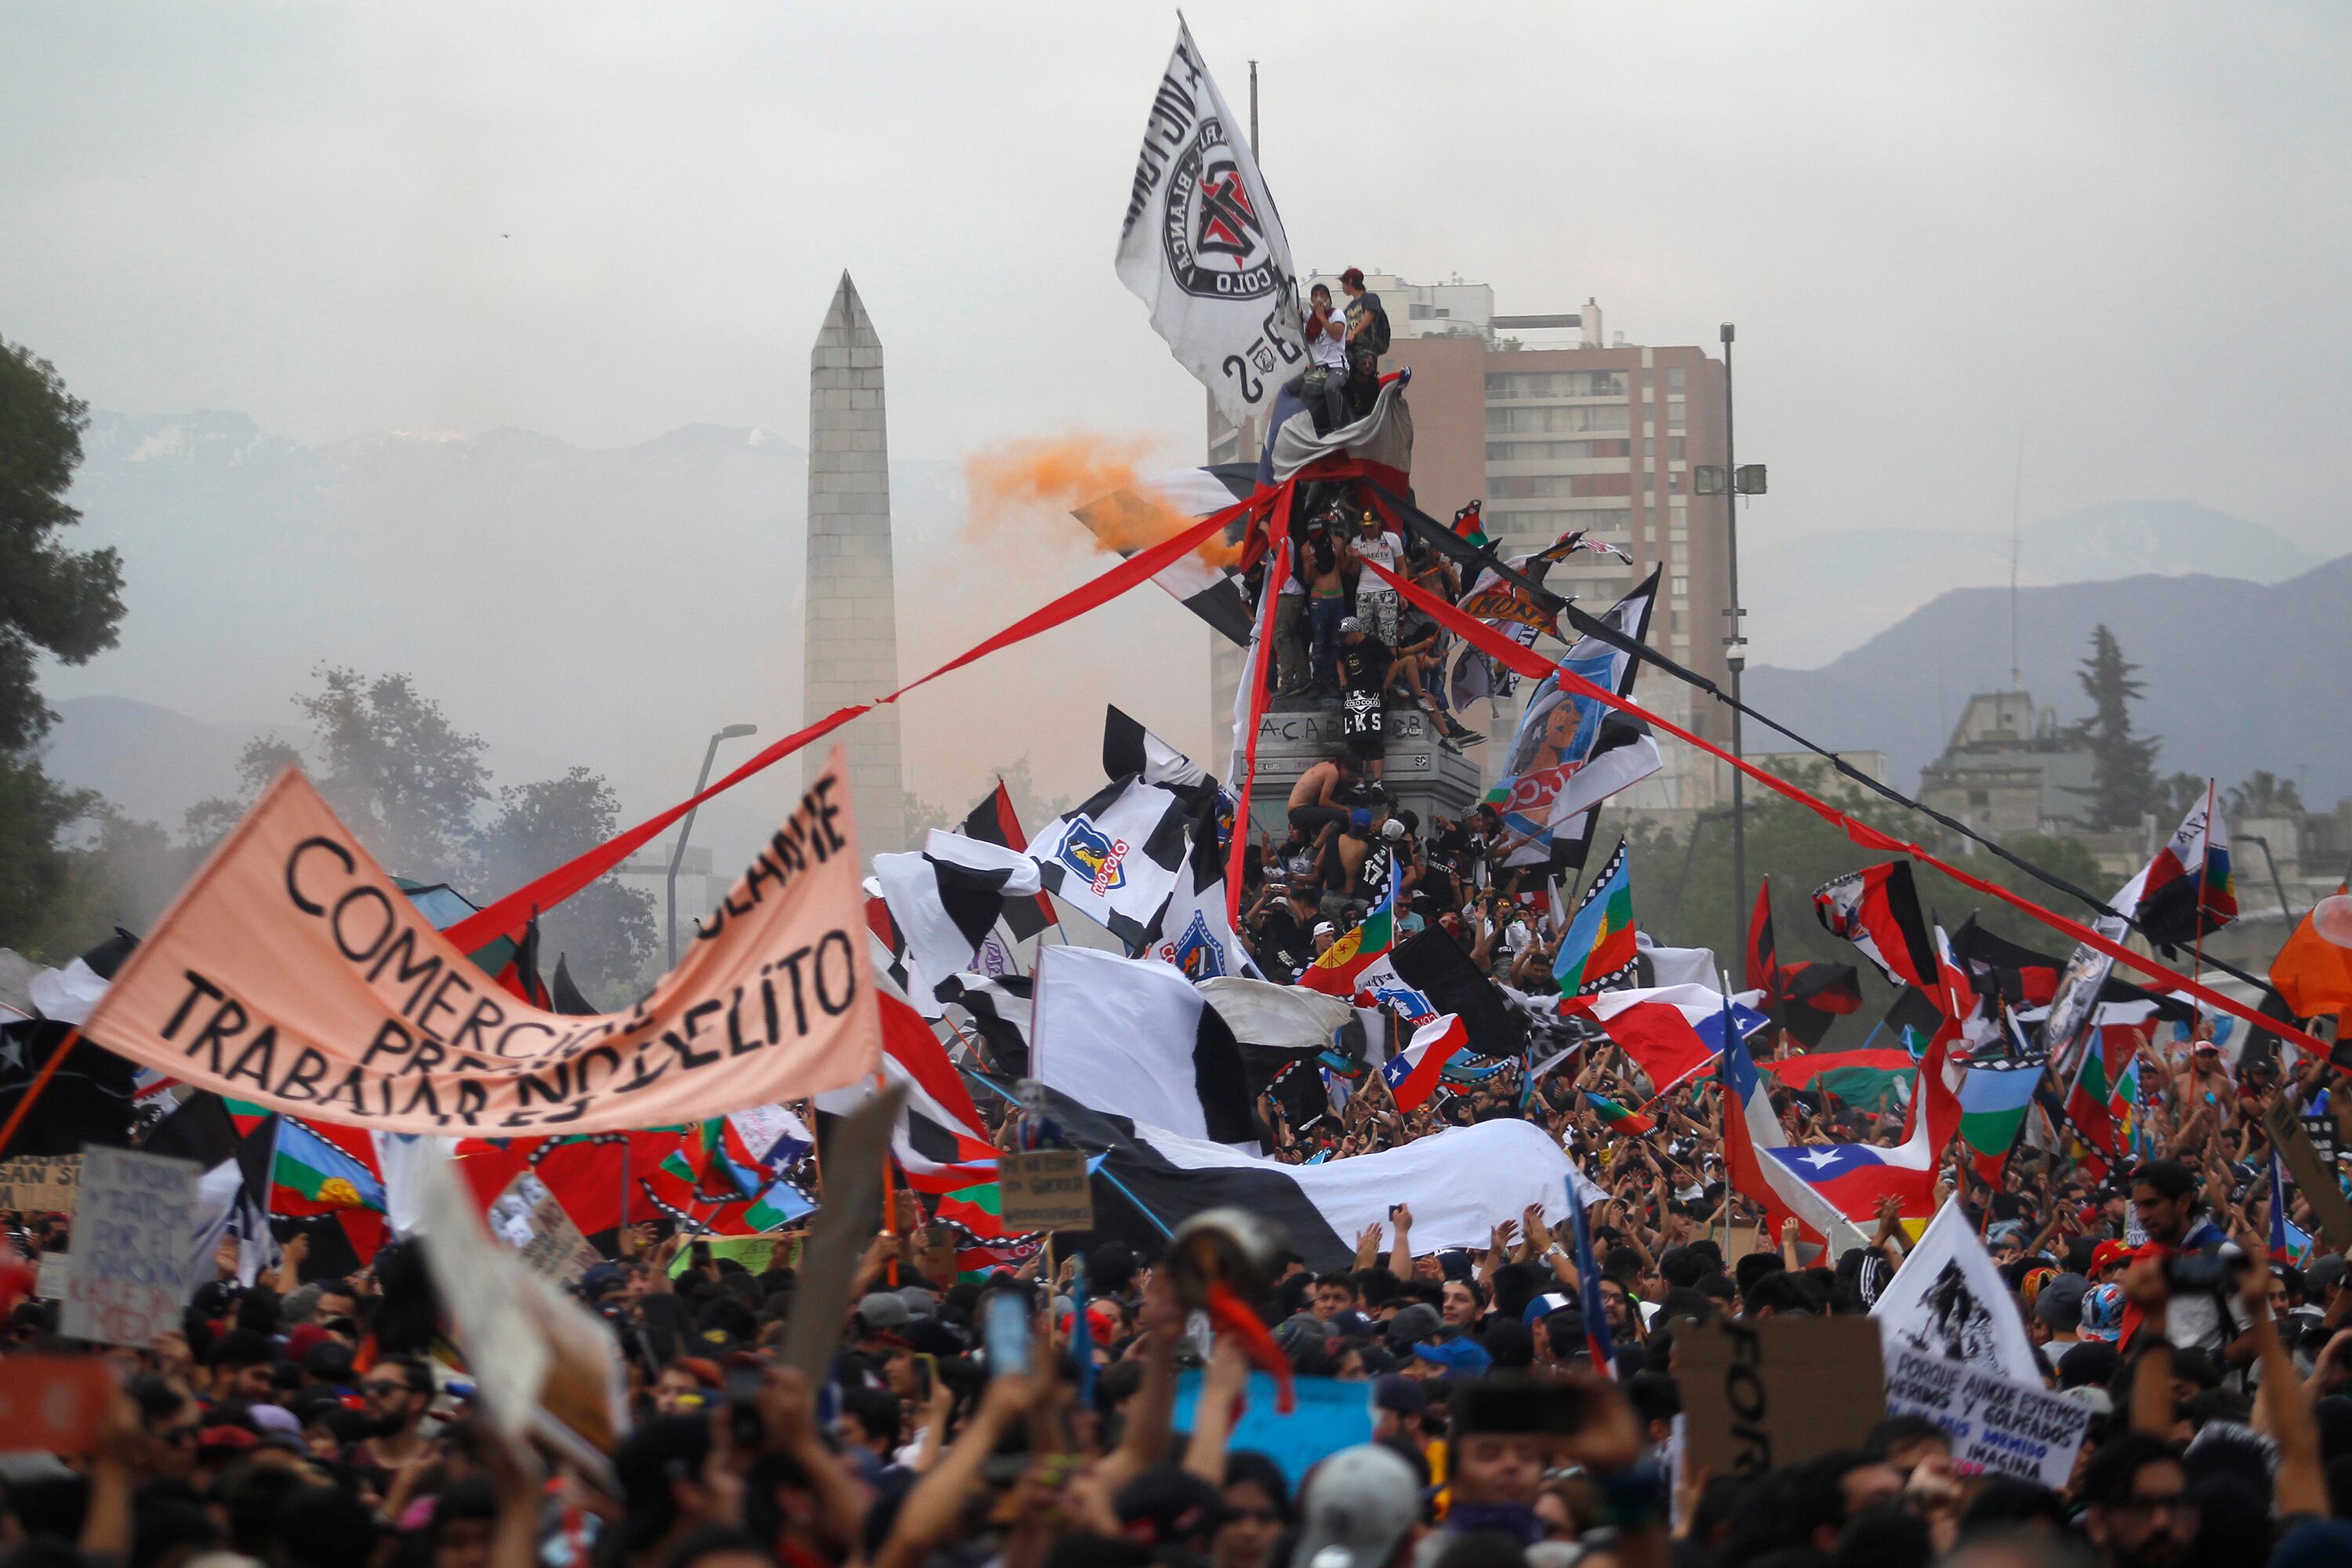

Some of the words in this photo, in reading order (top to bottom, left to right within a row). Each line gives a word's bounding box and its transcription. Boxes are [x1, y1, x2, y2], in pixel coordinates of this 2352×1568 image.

[1363, 860, 1384, 886] 17
[1428, 859, 1454, 875] DIRECTV
[1896, 1352, 1958, 1392] PORQUE
[1962, 1374, 2020, 1406] AUNQUE
[2018, 1392, 2086, 1430] ESTEMOS
[1962, 1396, 1978, 1417] Y
[1982, 1405, 2074, 1448] GOLPEADOS
[1966, 1443, 2041, 1479] IMAGINA
